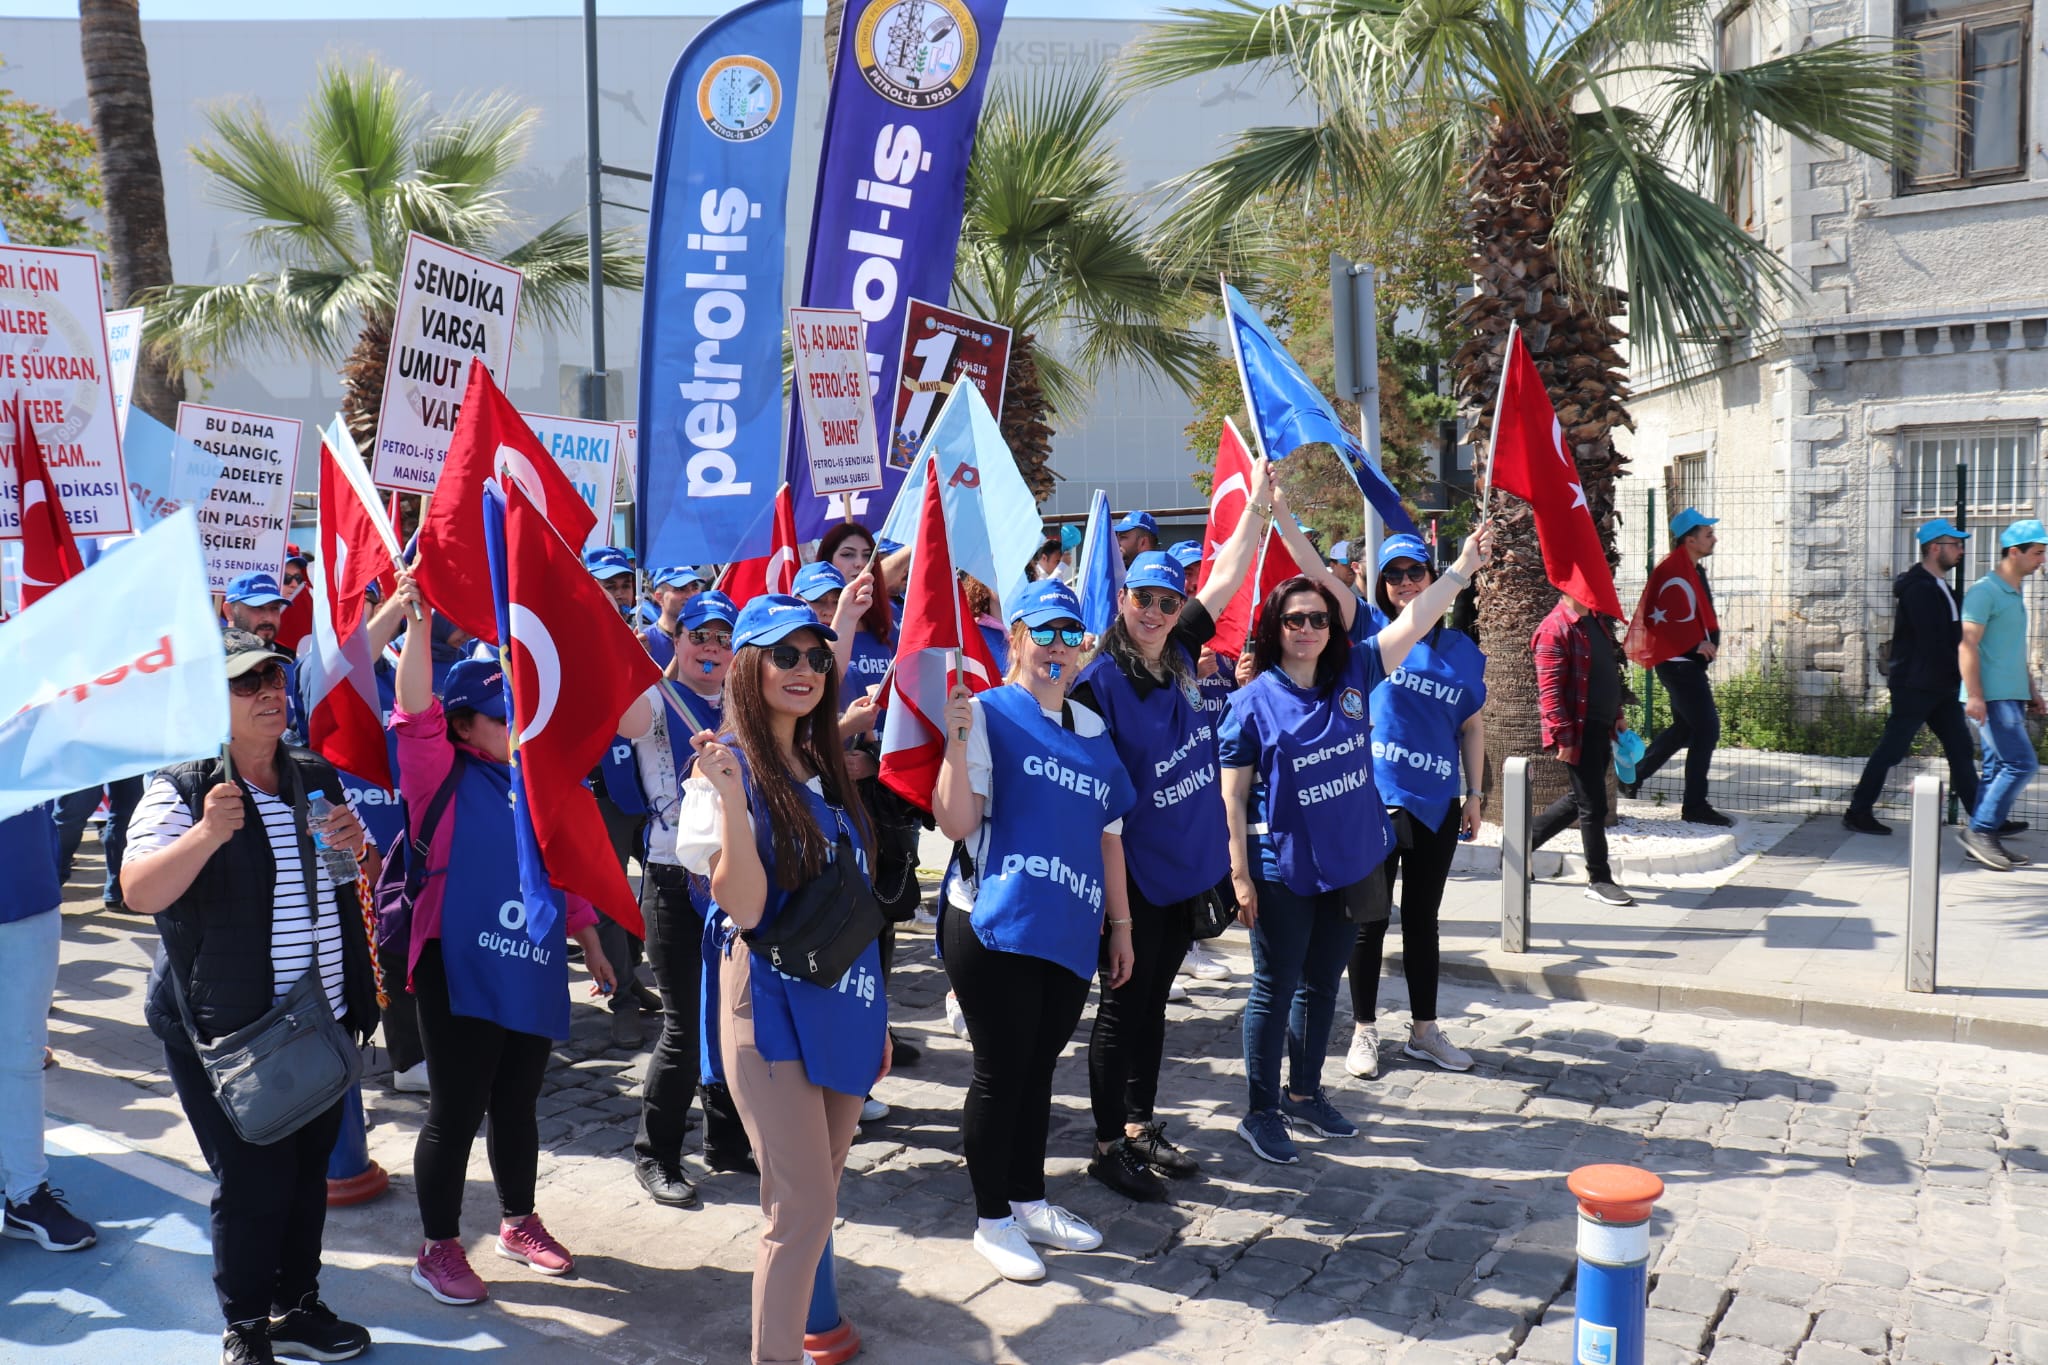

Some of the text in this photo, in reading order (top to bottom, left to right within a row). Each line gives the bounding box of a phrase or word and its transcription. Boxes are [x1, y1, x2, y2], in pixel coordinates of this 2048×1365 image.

[869, 70, 952, 106] PETROL-İŞ 1950
[750, 122, 768, 137] 1950
[20, 258, 59, 297] İÇİN
[414, 259, 504, 316] SENDİKA
[422, 305, 486, 354] VARSA
[679, 186, 762, 498] petrol-iş
[812, 324, 825, 358] AŞ
[826, 325, 859, 350] ADALET
[937, 322, 981, 342] petrol-iş
[21, 348, 100, 386] ŞÜKRAN,
[399, 346, 462, 389] UMUT
[809, 364, 861, 405] PETROL-İŞE
[912, 331, 957, 437] 1
[919, 381, 941, 392] MAYIS
[205, 417, 274, 439] BU DAHA
[822, 419, 859, 447] EMANET
[382, 438, 434, 463] PETROL-İŞ
[551, 433, 610, 463] FARKI
[393, 466, 436, 484] MANİSA
[225, 512, 284, 531] PLASTİK
[1385, 665, 1464, 706] ÖREVLİ
[1292, 733, 1365, 773] petrol-iş
[1298, 763, 1368, 807] SENDİKA
[1001, 853, 1103, 914] petrol-iş
[478, 931, 550, 966] GÜÇLÜ OL!
